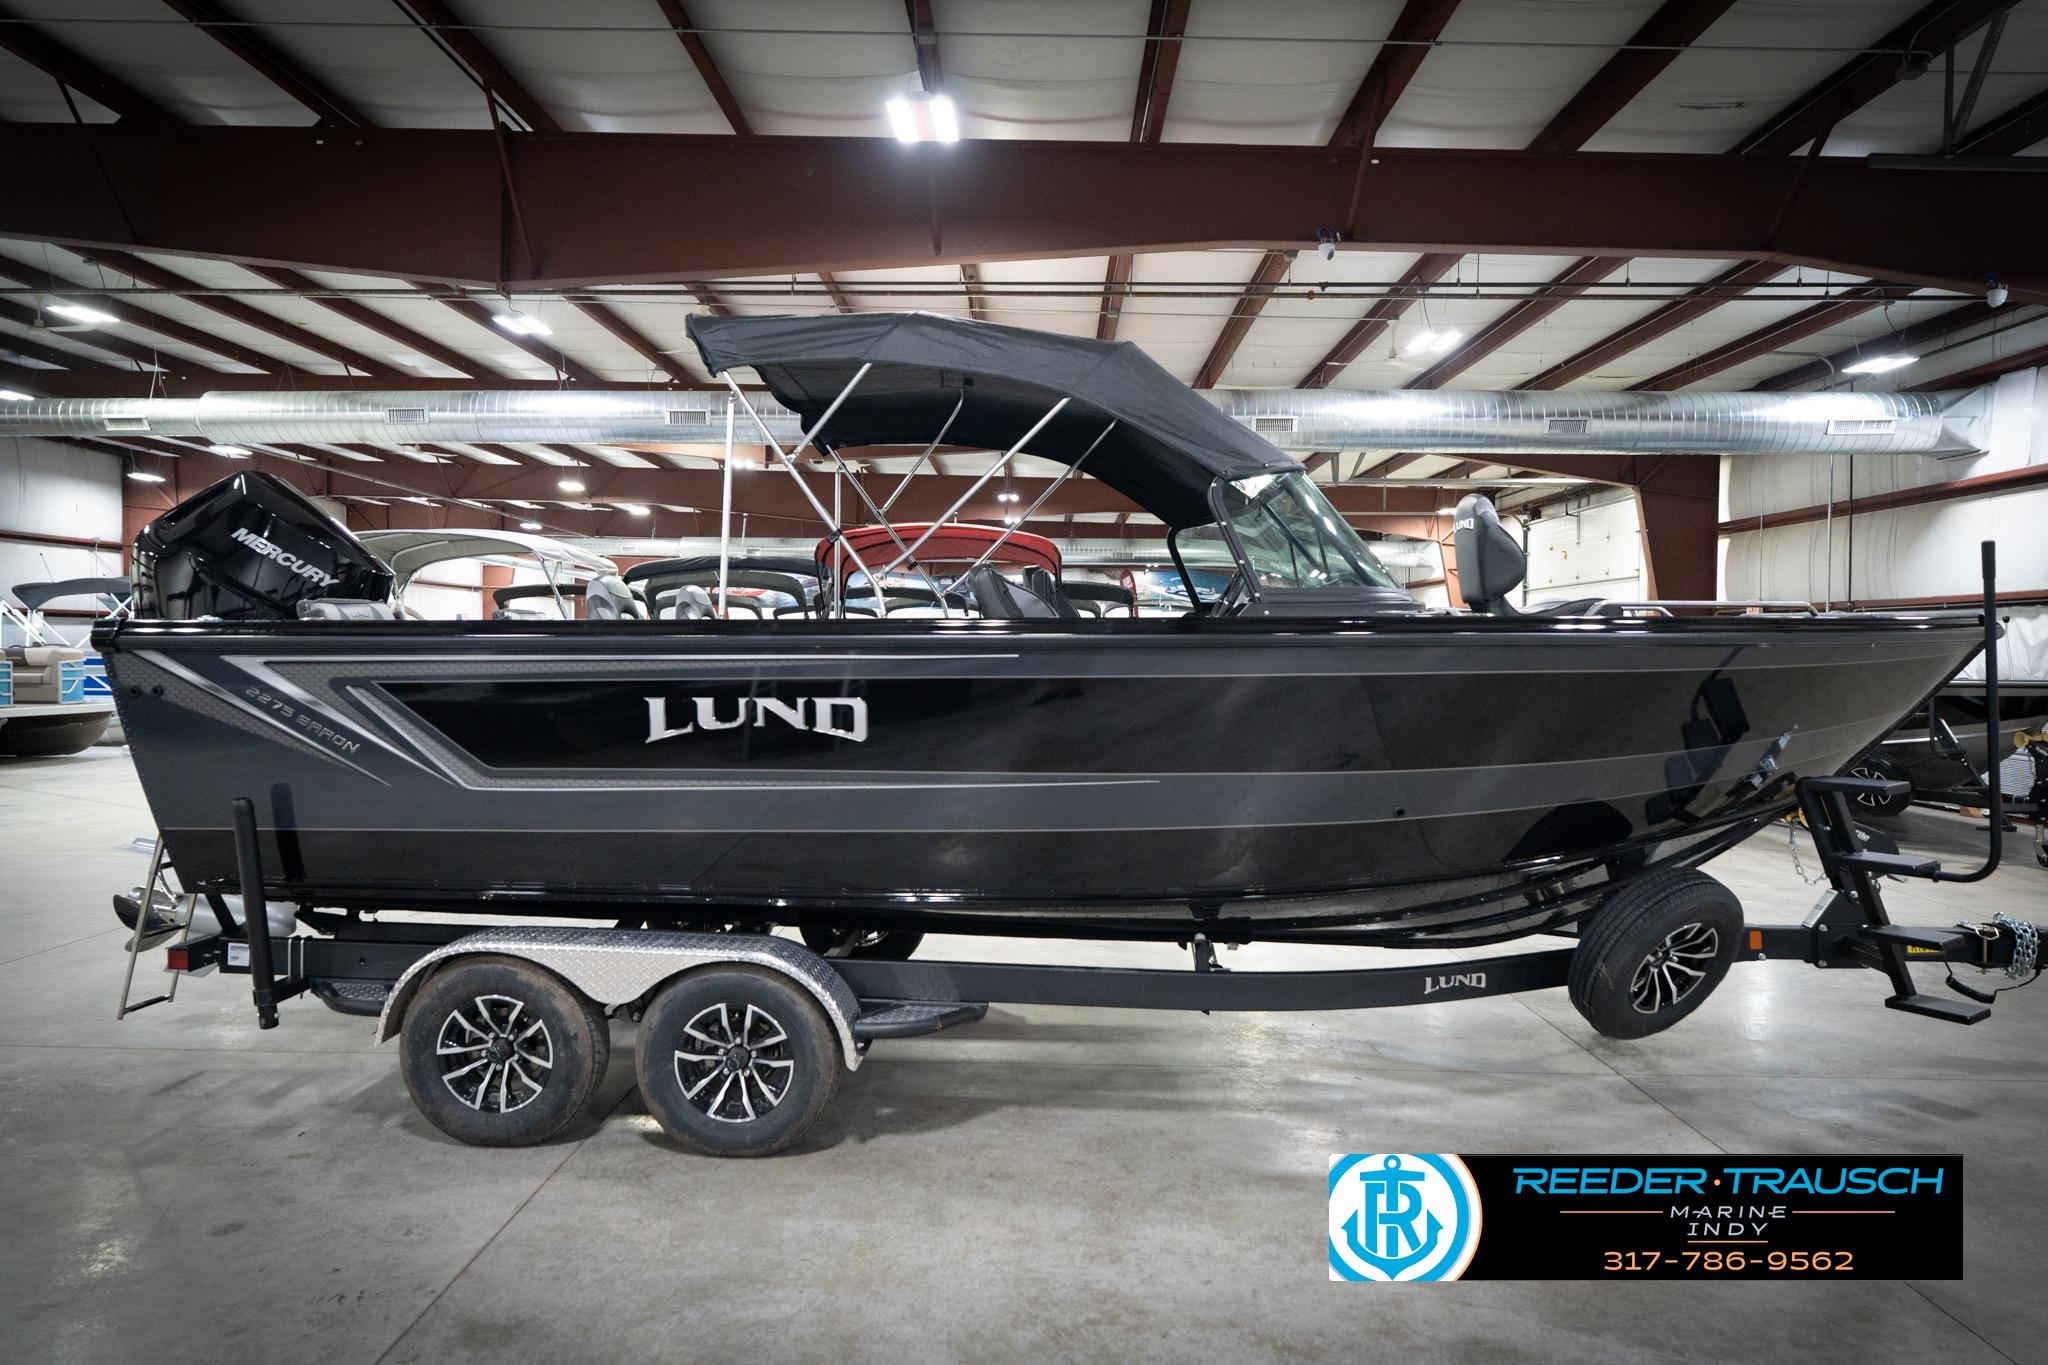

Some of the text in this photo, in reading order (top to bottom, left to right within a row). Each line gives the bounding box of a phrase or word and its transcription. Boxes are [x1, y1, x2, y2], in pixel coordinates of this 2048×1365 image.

[230, 527, 340, 587] MERCURY
[245, 686, 361, 754] 2275 BARON
[643, 696, 868, 744] LUND
[1423, 972, 1487, 995] LUND
